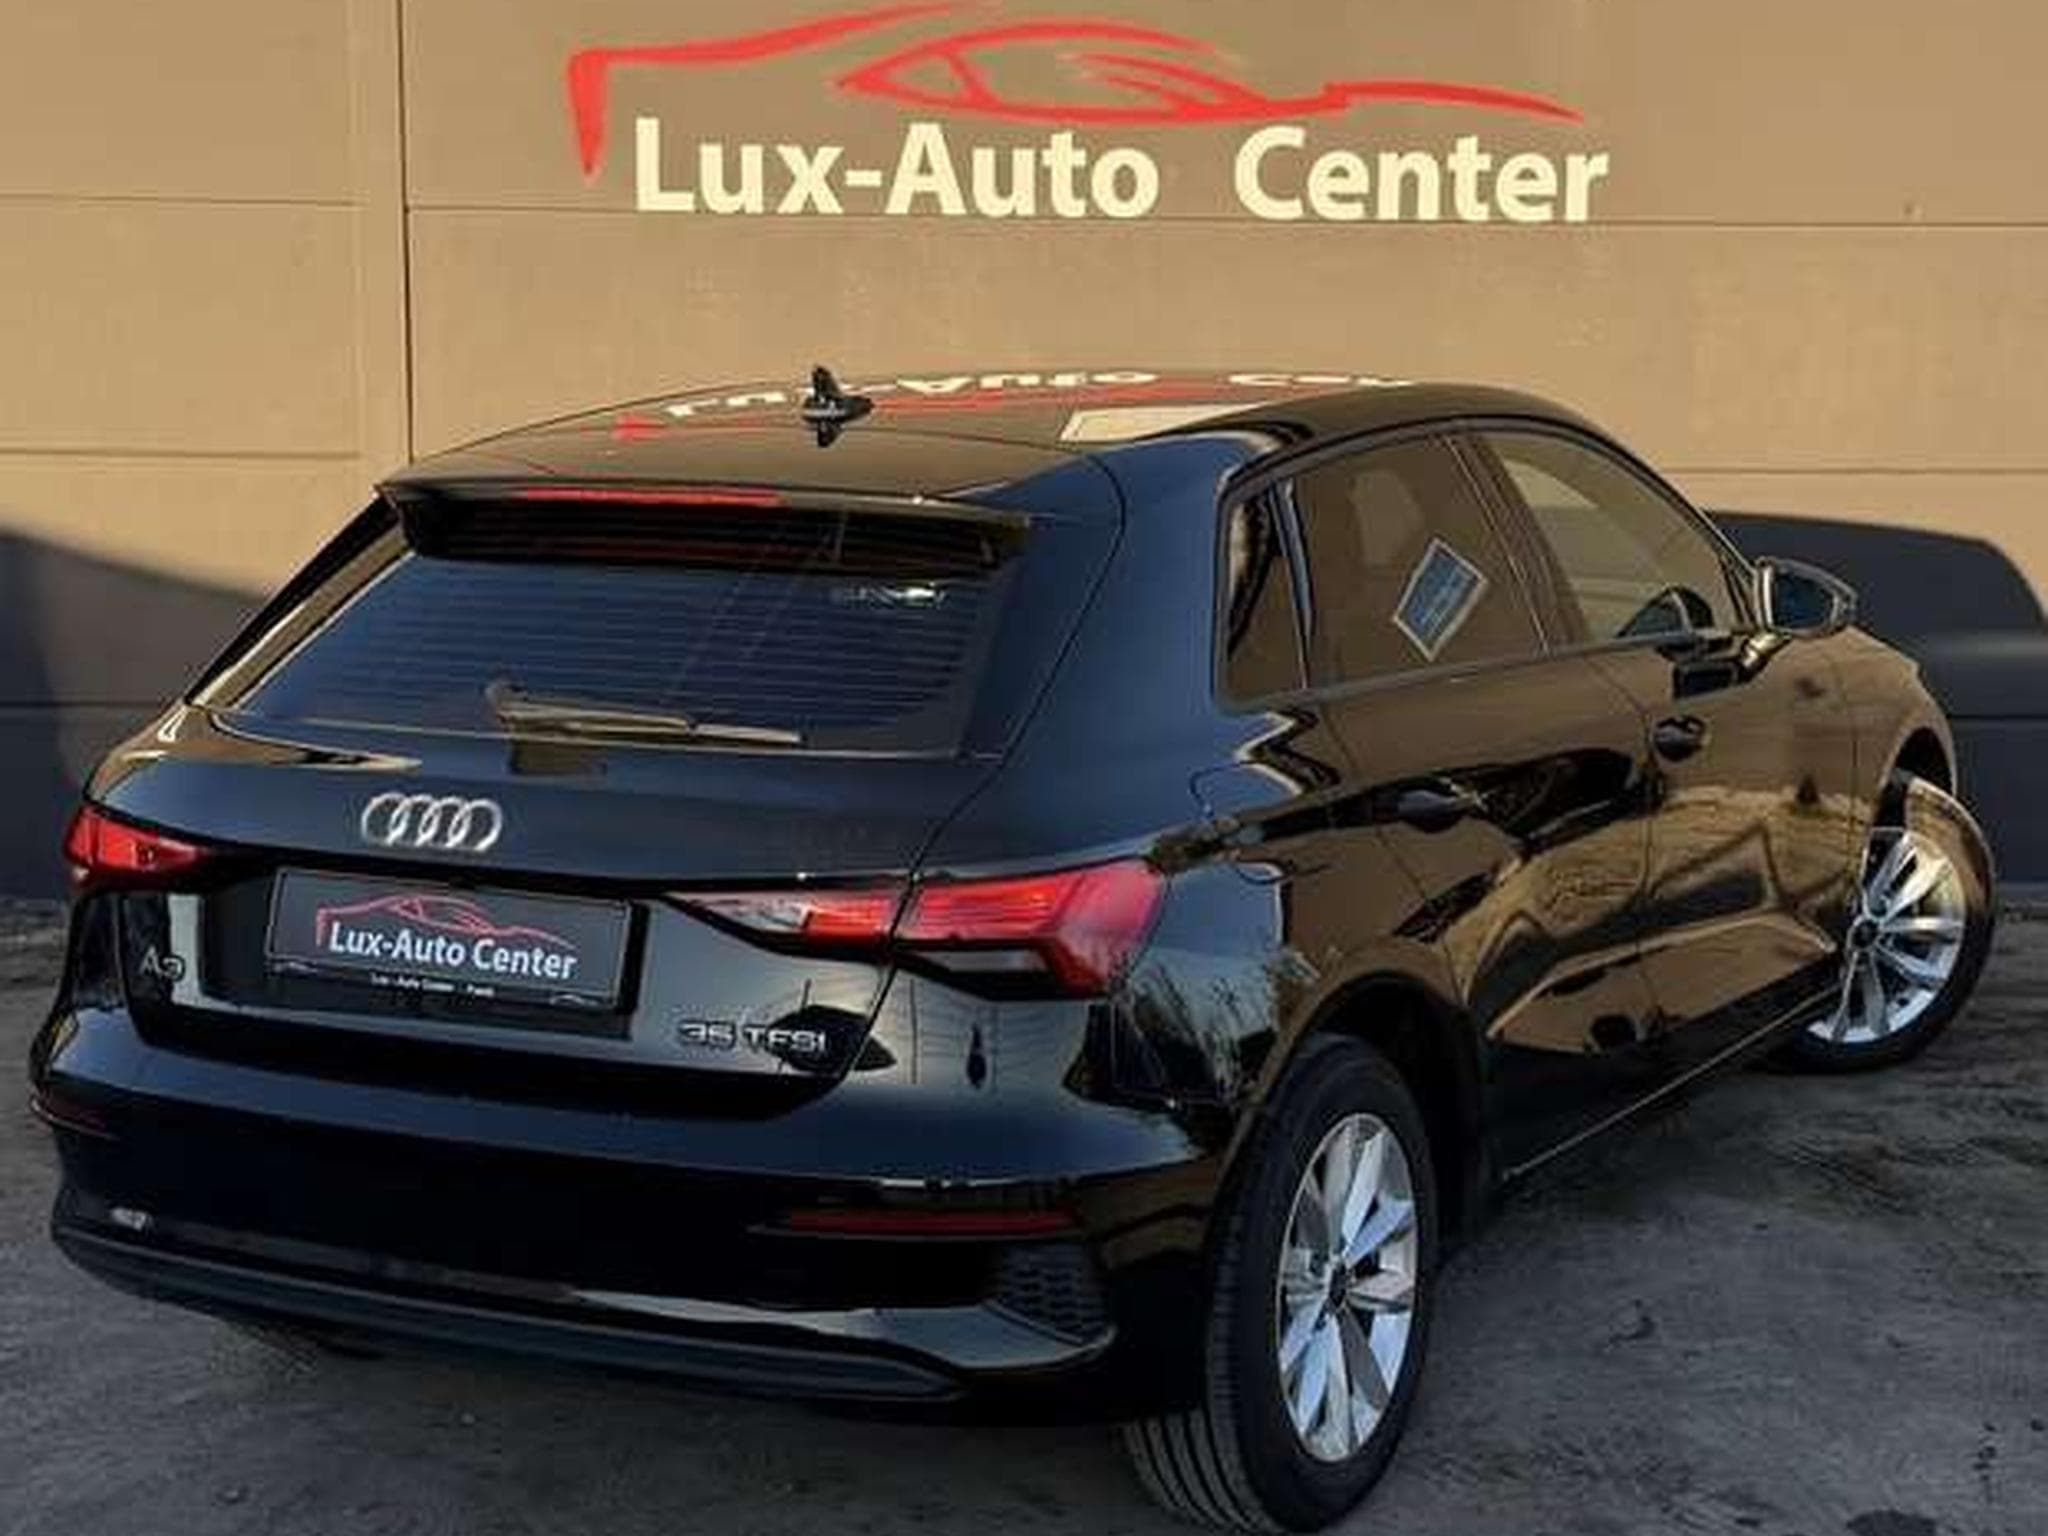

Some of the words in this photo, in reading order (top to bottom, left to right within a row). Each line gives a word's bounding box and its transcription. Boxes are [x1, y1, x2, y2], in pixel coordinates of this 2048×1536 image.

[635, 117, 1159, 218] Lux-Auto
[1234, 125, 1609, 221] Center
[139, 944, 183, 980] A3
[329, 920, 465, 966] Lux-Auto
[472, 938, 577, 979] Center
[679, 1021, 735, 1048] 35
[743, 1025, 827, 1052] TFSI
